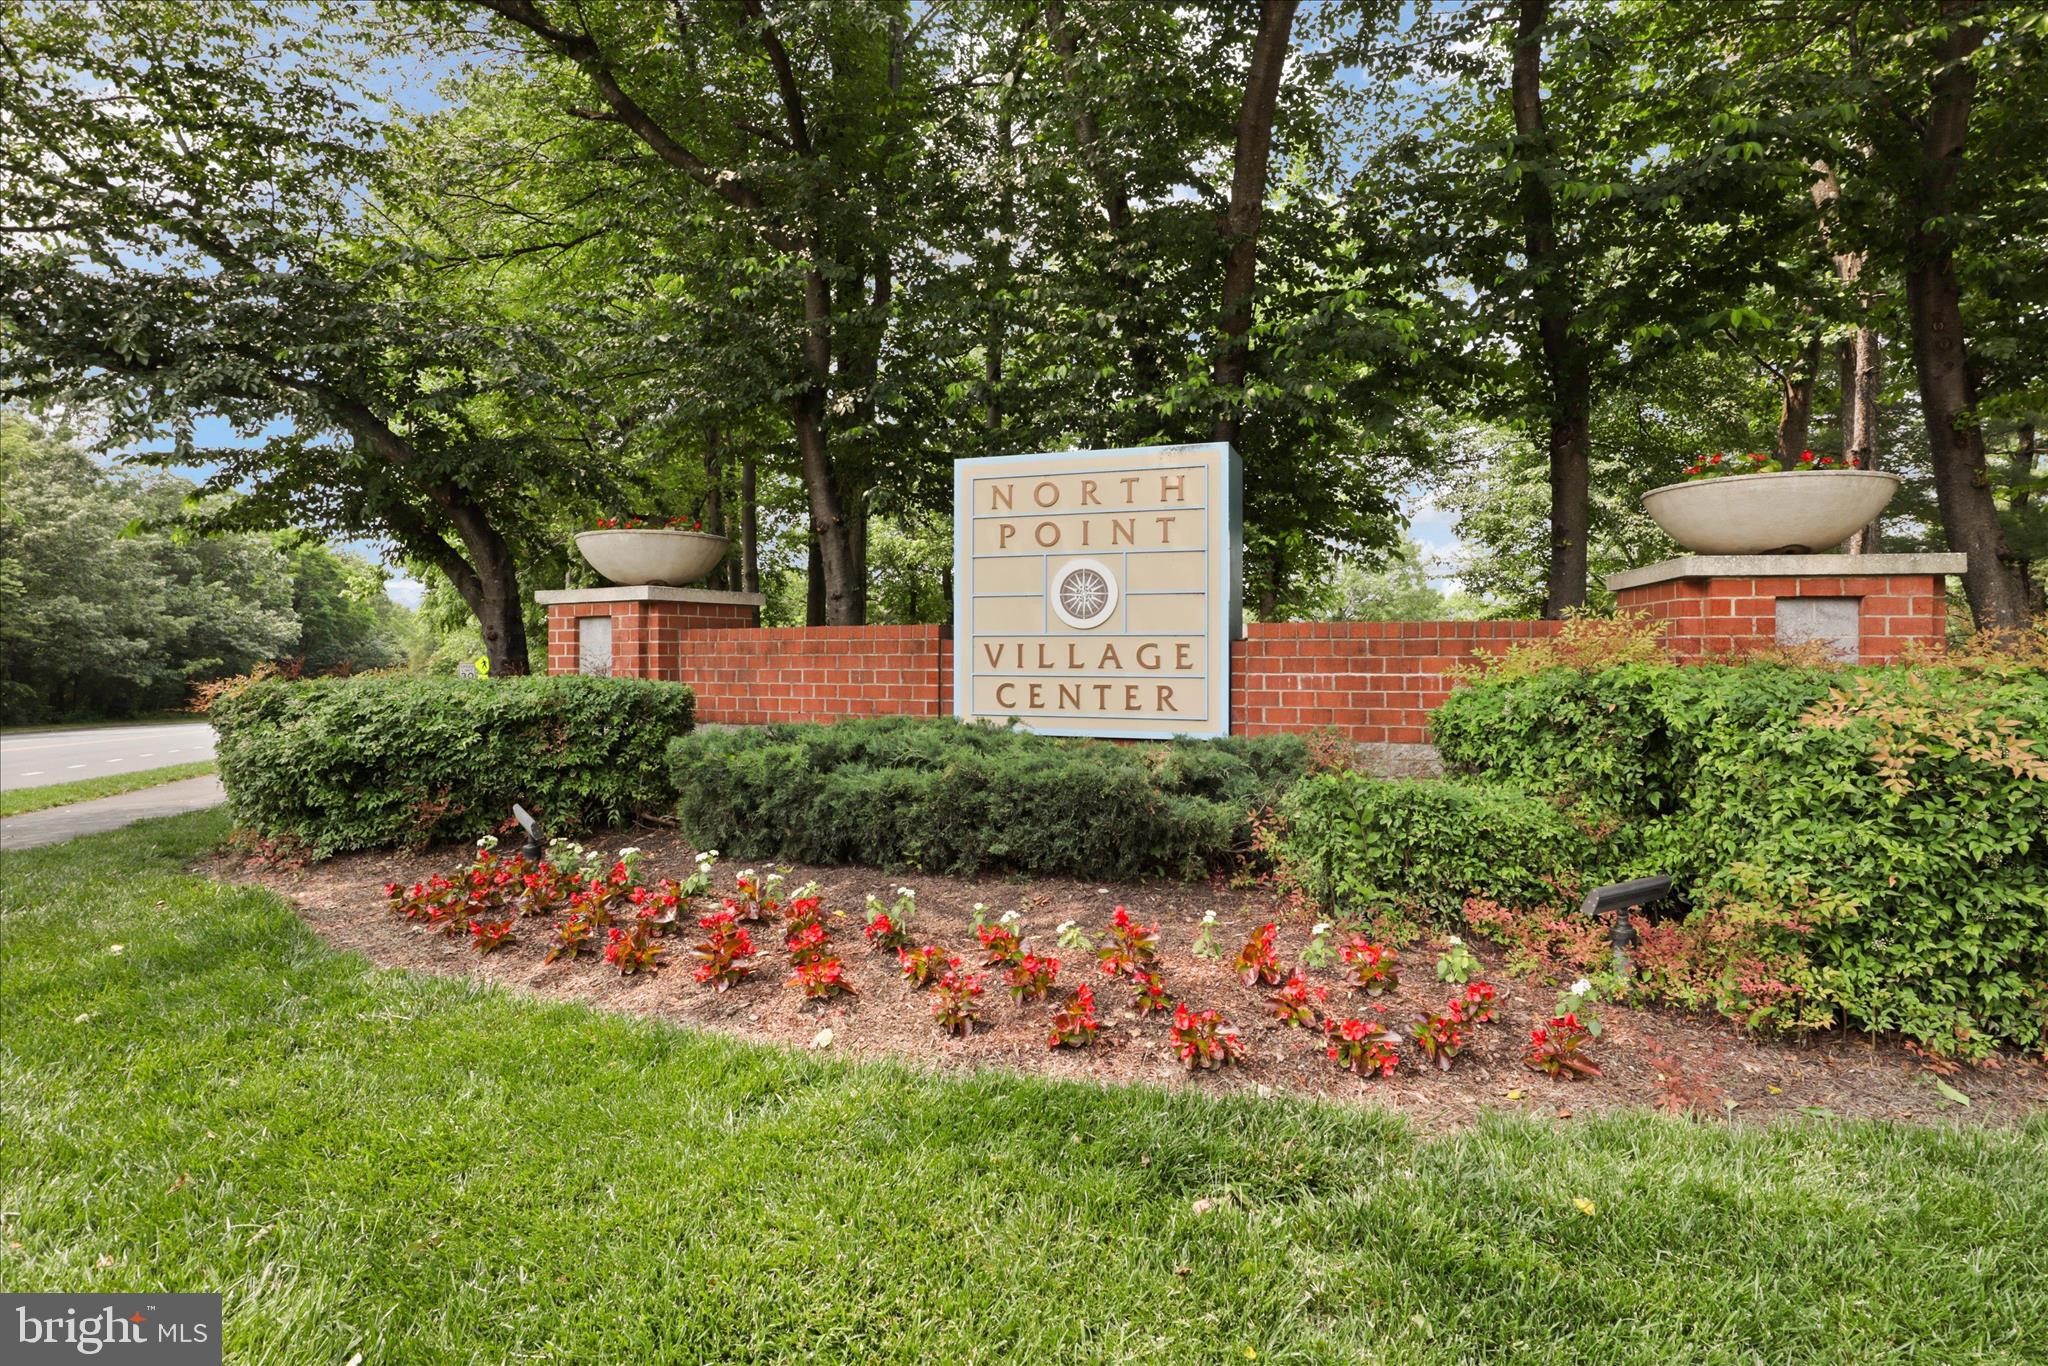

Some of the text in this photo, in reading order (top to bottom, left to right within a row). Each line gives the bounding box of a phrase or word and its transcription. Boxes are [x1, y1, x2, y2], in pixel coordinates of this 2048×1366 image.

[991, 475, 1185, 510] NORTH
[999, 517, 1175, 549] POINT
[984, 642, 1193, 670] VILLAGE
[996, 682, 1178, 712] CENTER
